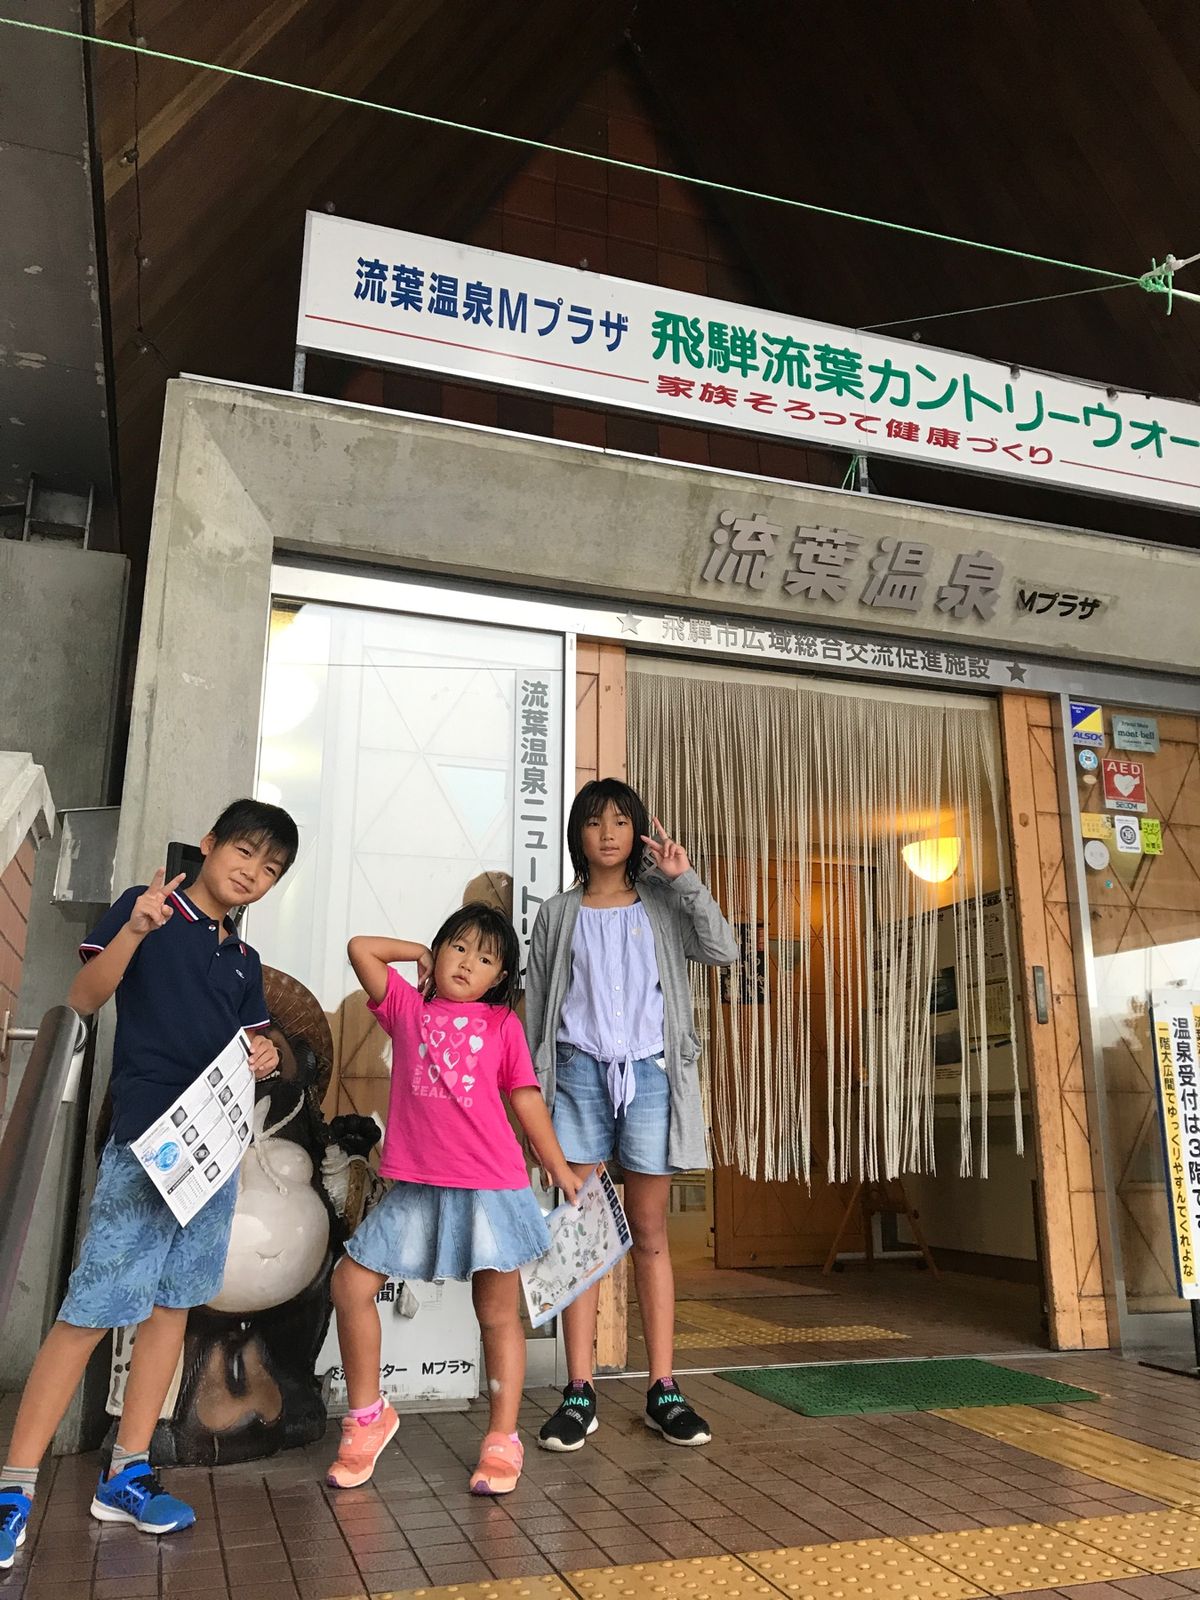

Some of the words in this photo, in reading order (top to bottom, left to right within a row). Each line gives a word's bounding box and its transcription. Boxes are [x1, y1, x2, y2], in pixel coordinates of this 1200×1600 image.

[353, 256, 629, 352] 流葉温泉Mプラザ
[655, 374, 1053, 466] 家族そろって健康づくり
[702, 509, 1004, 622] 流葉温泉
[1017, 588, 1102, 621] Mプラザ
[1073, 731, 1103, 742] ALSOK
[1106, 761, 1141, 775] AED
[520, 679, 549, 978] 流葉温泉ニュート
[411, 1084, 474, 1108] ZEALD
[1172, 1017, 1200, 1229] 温泉受付は3階
[562, 1396, 590, 1409] ANAP
[666, 1406, 685, 1421] GIRL
[565, 1408, 584, 1425] GIRL
